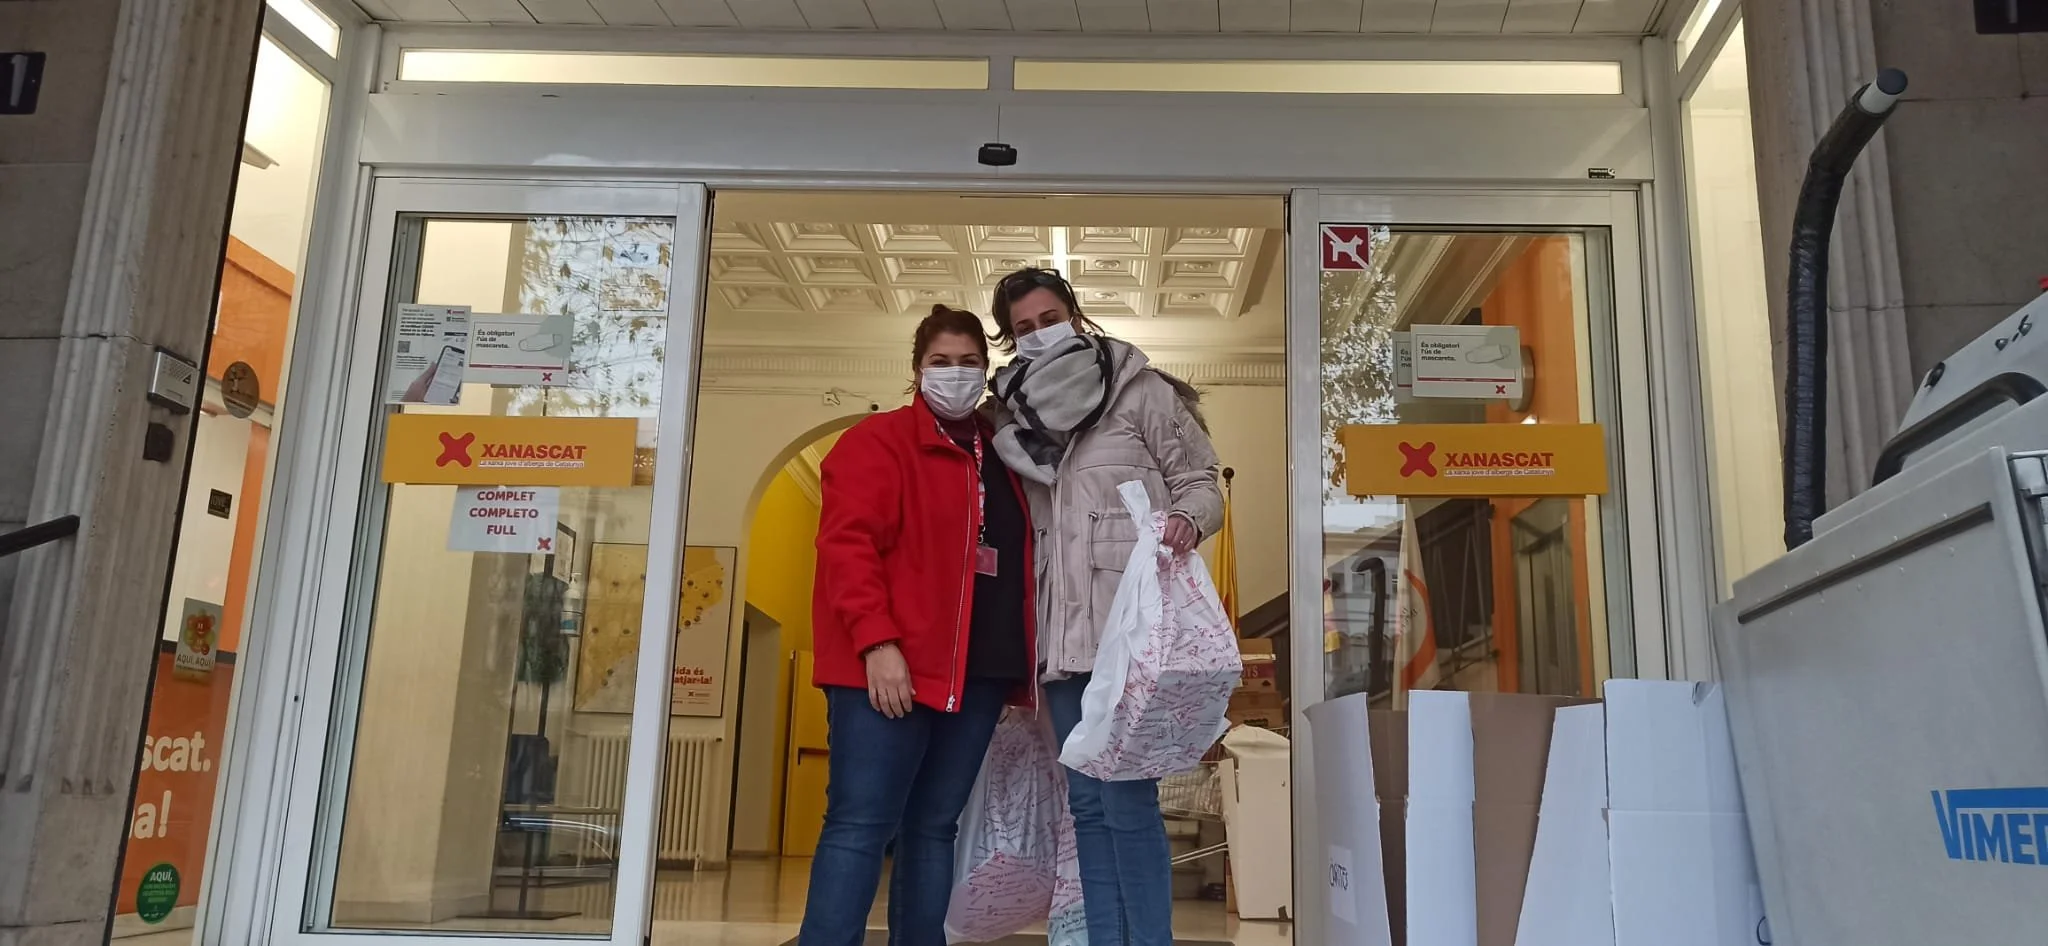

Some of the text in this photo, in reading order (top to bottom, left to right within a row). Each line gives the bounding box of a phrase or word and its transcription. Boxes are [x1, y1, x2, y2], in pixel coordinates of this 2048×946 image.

[480, 443, 587, 459] XANASCAT
[1444, 453, 1554, 467] XANASCAT
[477, 491, 536, 501] COMPLET
[469, 507, 539, 518] COMPLETO
[486, 525, 517, 535] FULL
[675, 666, 704, 675] ida és
